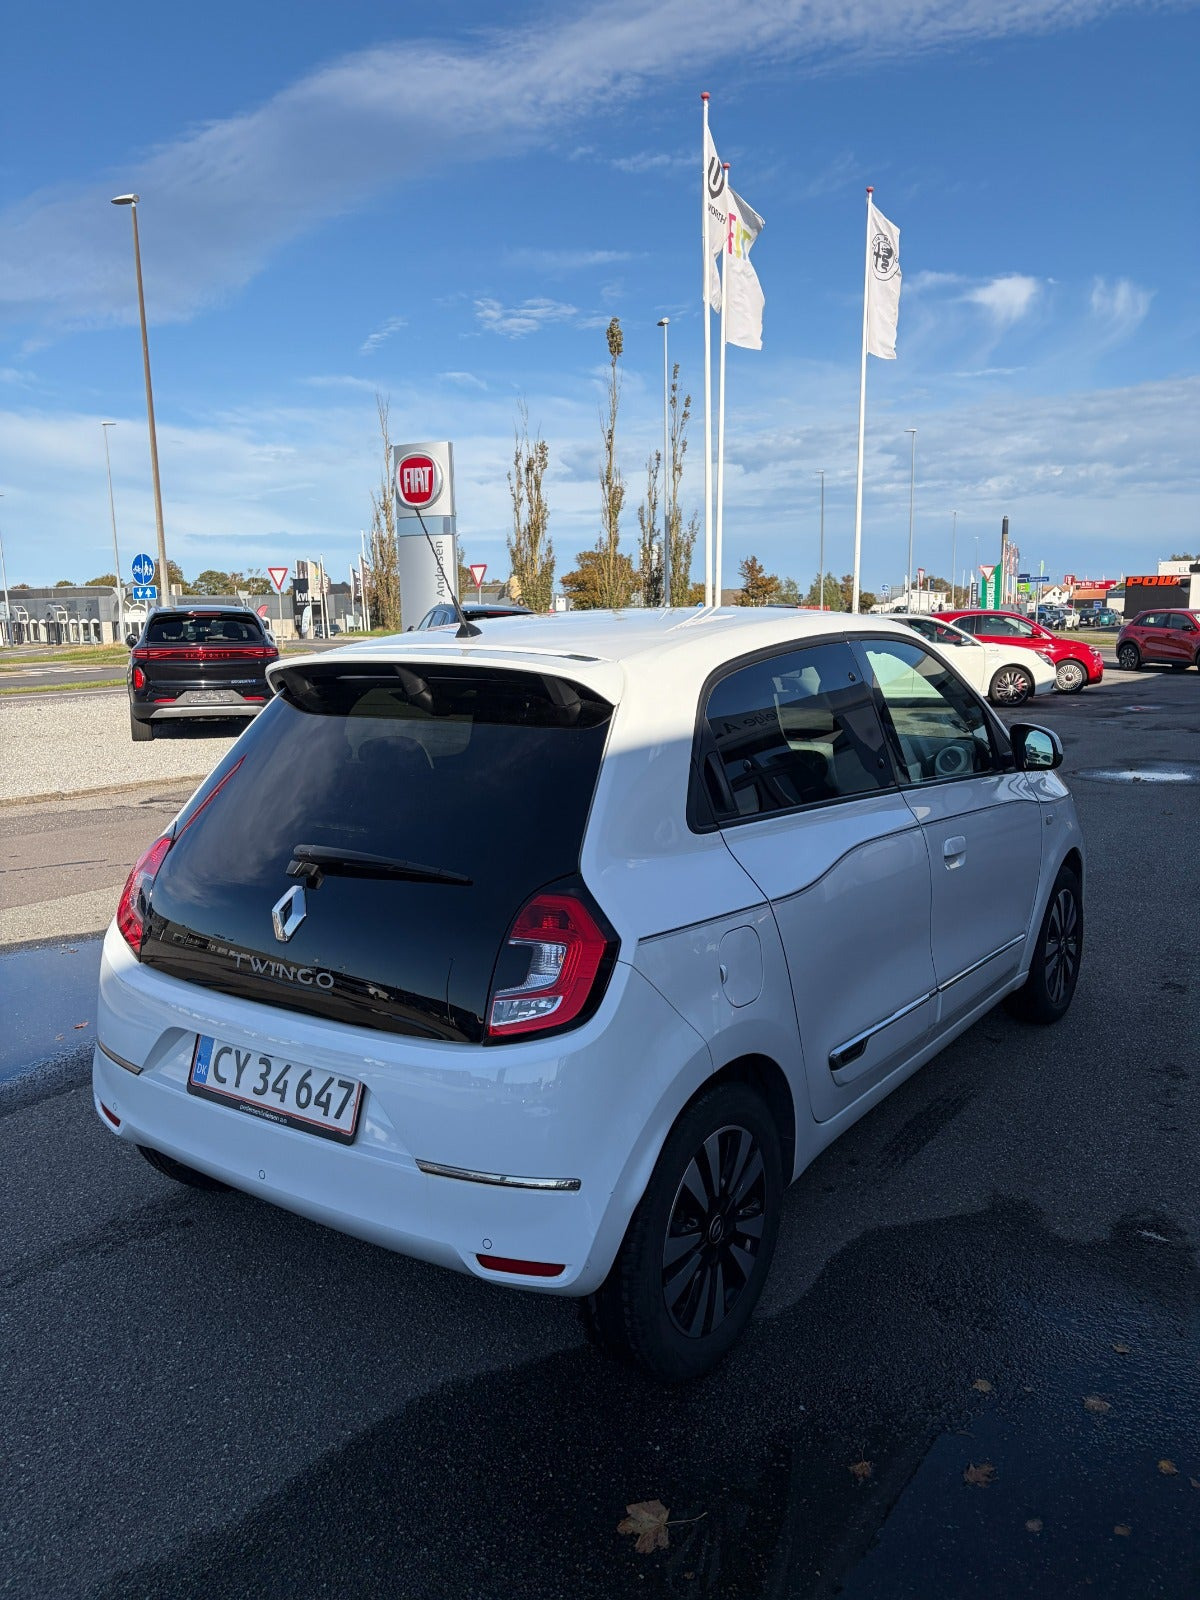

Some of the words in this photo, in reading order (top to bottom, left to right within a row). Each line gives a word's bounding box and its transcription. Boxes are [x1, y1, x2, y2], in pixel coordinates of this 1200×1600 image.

[403, 467, 431, 493] FIAT
[296, 590, 308, 601] kvi
[234, 953, 334, 989] TWINGO
[197, 1063, 208, 1075] DK
[213, 1046, 251, 1088] CY
[252, 1057, 291, 1103] 34
[295, 1068, 355, 1120] 647
